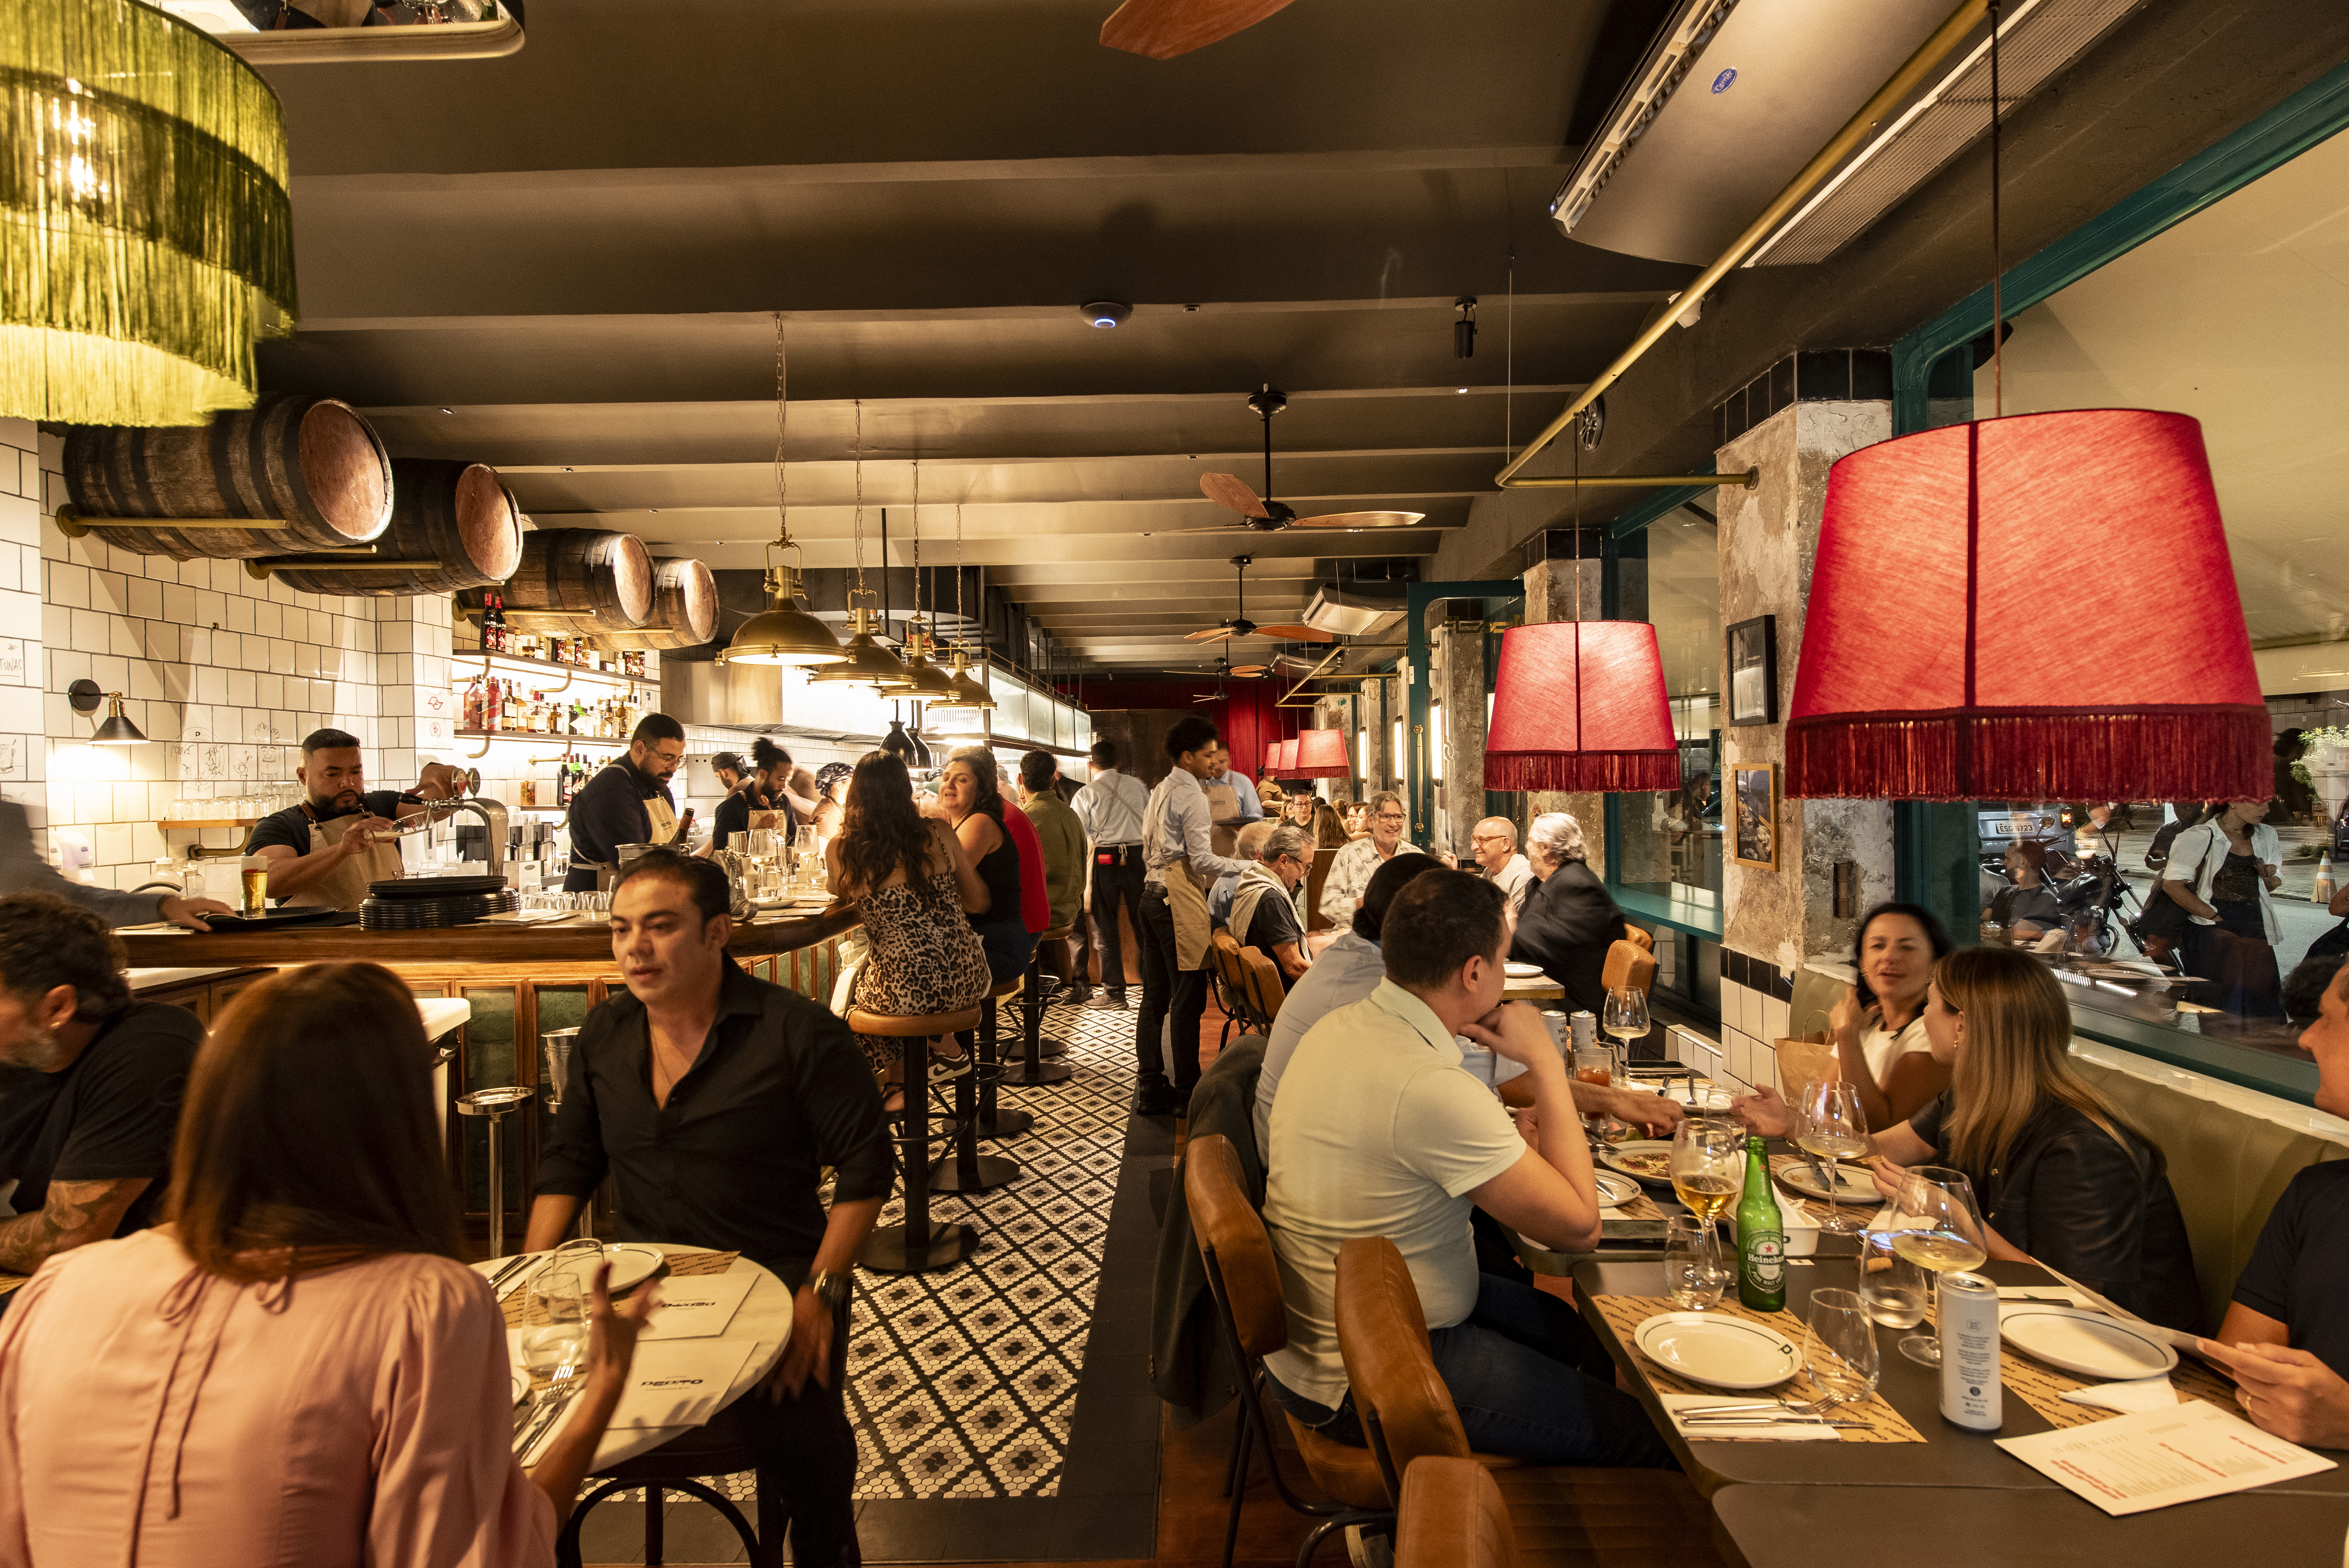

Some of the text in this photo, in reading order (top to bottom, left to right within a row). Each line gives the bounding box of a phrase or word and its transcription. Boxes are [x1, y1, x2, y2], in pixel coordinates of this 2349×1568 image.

[1715, 70, 1733, 91] Carrier
[1748, 1253, 1785, 1264] Heineken
[1778, 1343, 1793, 1354] P
